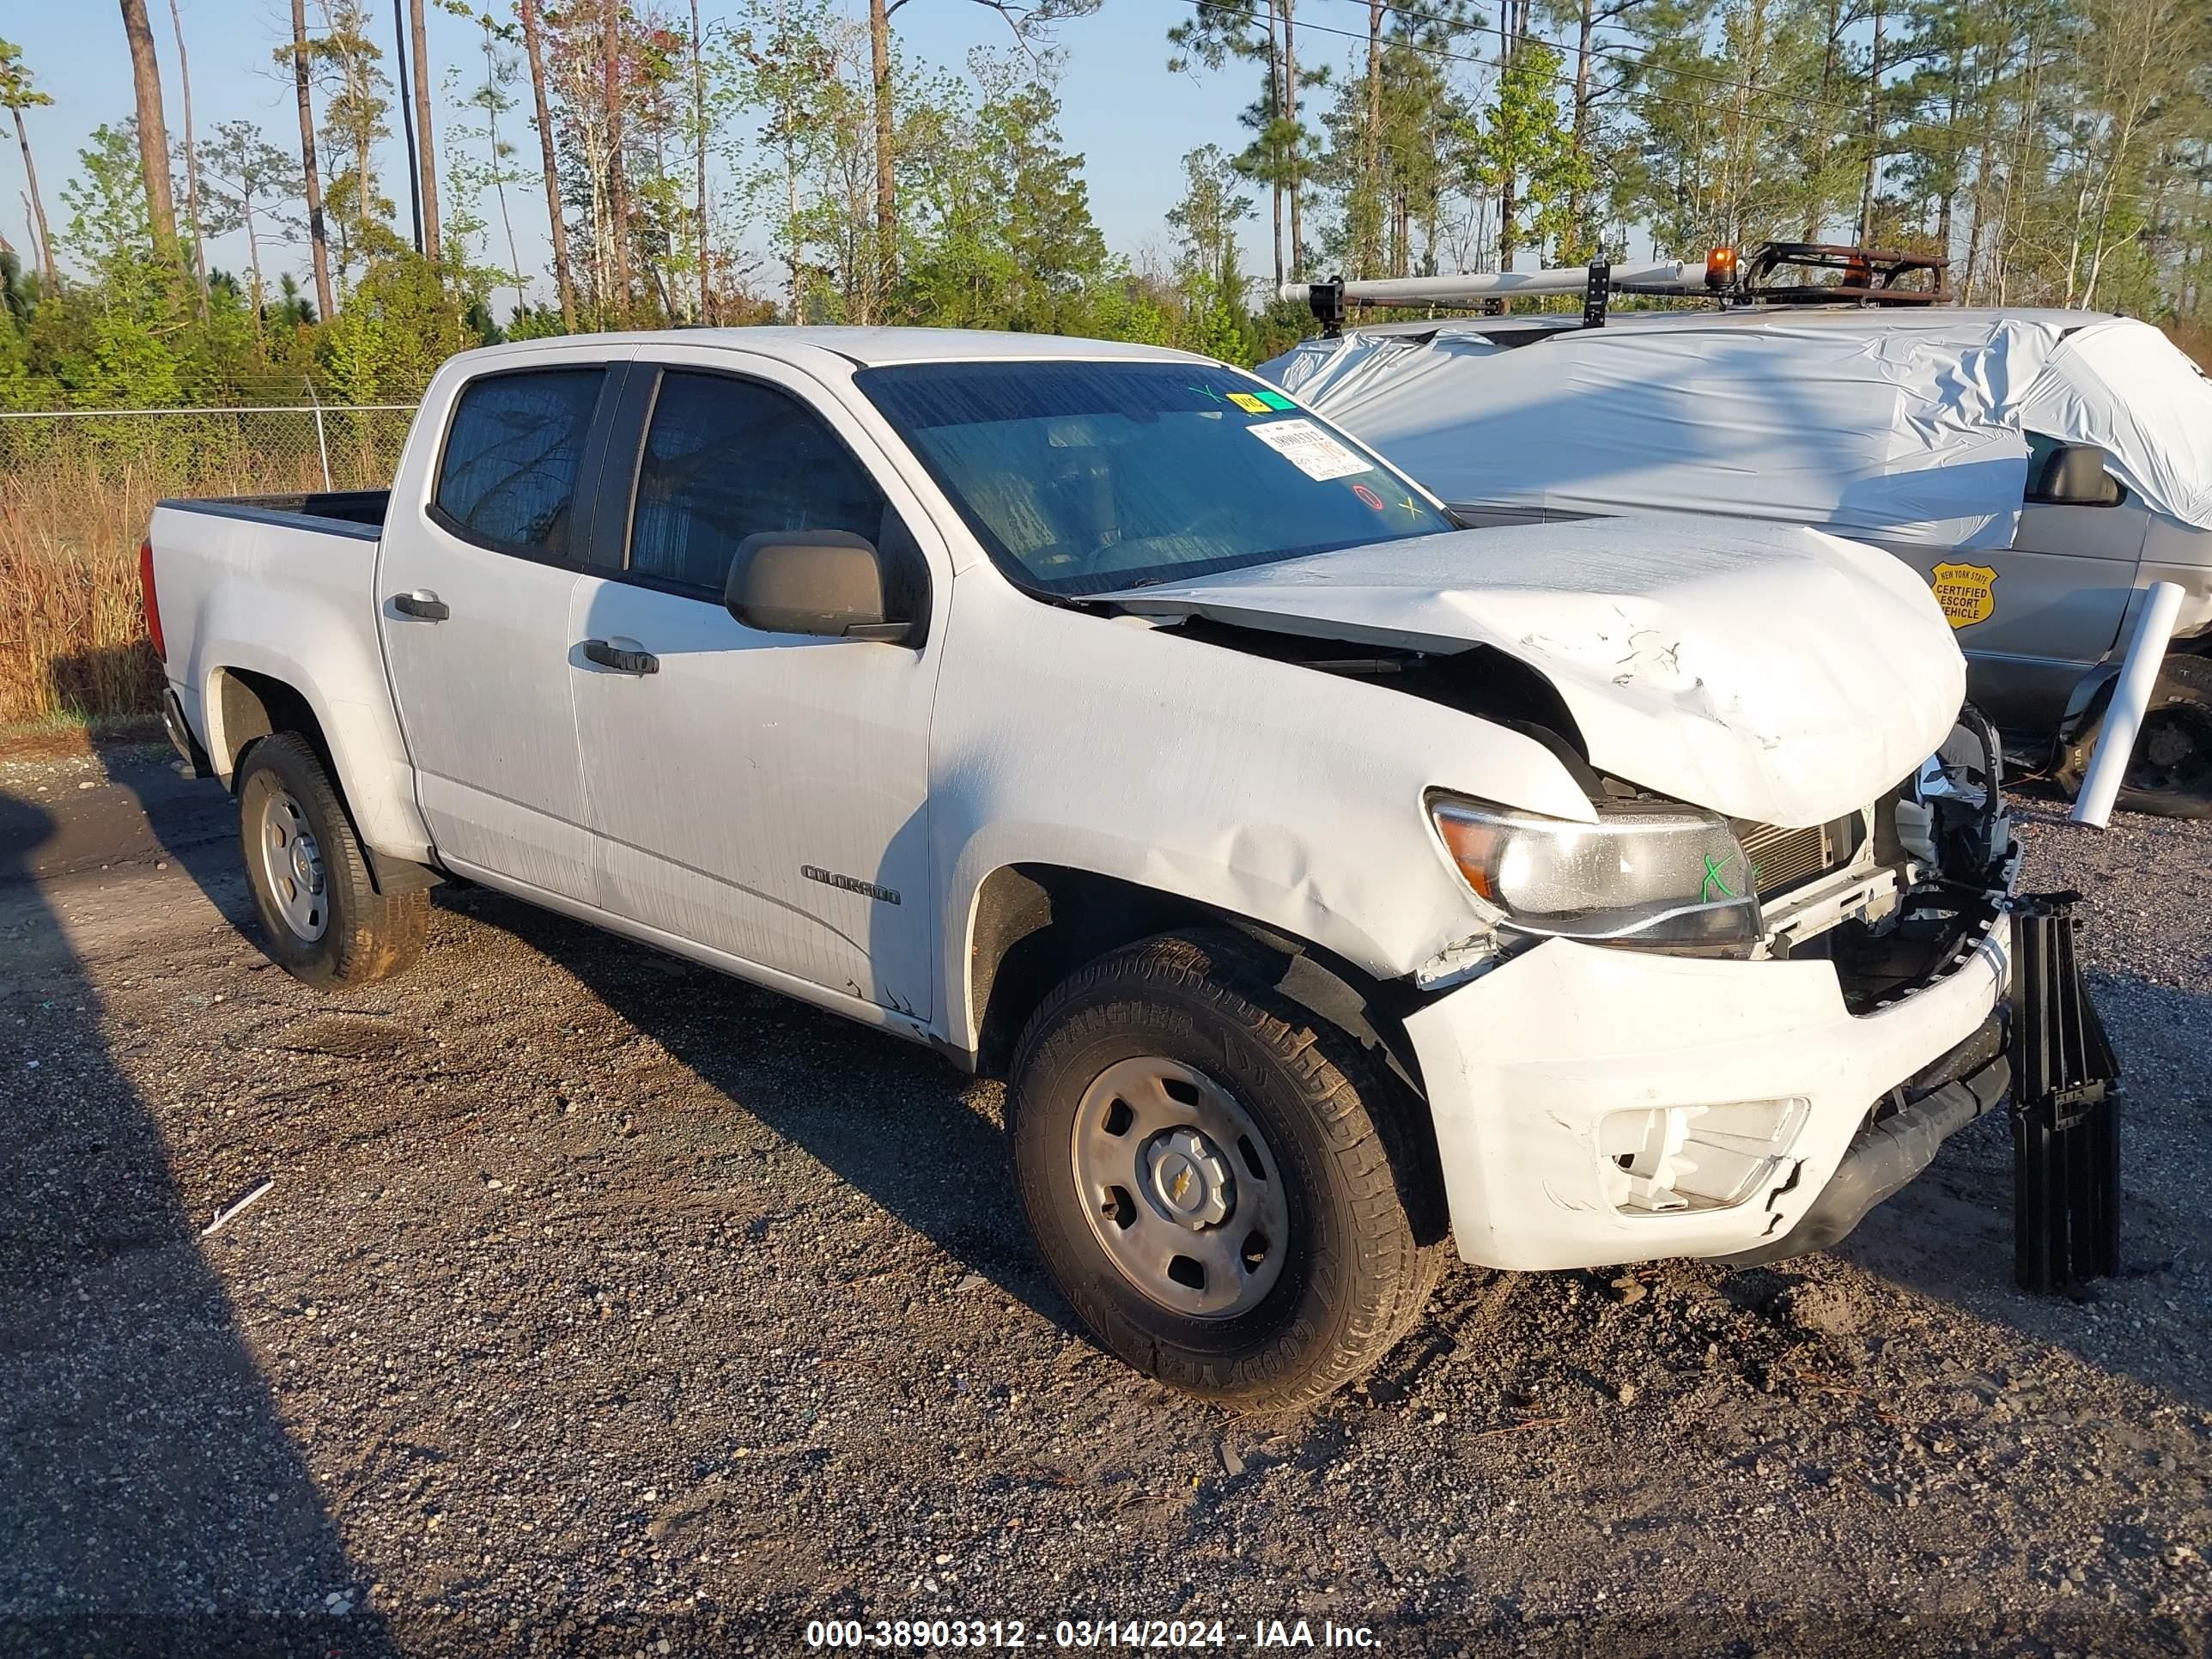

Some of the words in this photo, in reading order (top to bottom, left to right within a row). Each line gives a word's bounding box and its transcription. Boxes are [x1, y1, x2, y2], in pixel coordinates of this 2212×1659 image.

[1270, 431, 1324, 447] 38903312
[1941, 570, 1954, 580] NEW
[1954, 569, 1969, 579] YORK
[1971, 572, 1989, 584] STATE
[1936, 584, 1987, 599] CERTIFIED
[1940, 595, 1979, 609] ESCORT
[800, 865, 901, 905] COLORADO
[1032, 1000, 1194, 1078] WRANGLER
